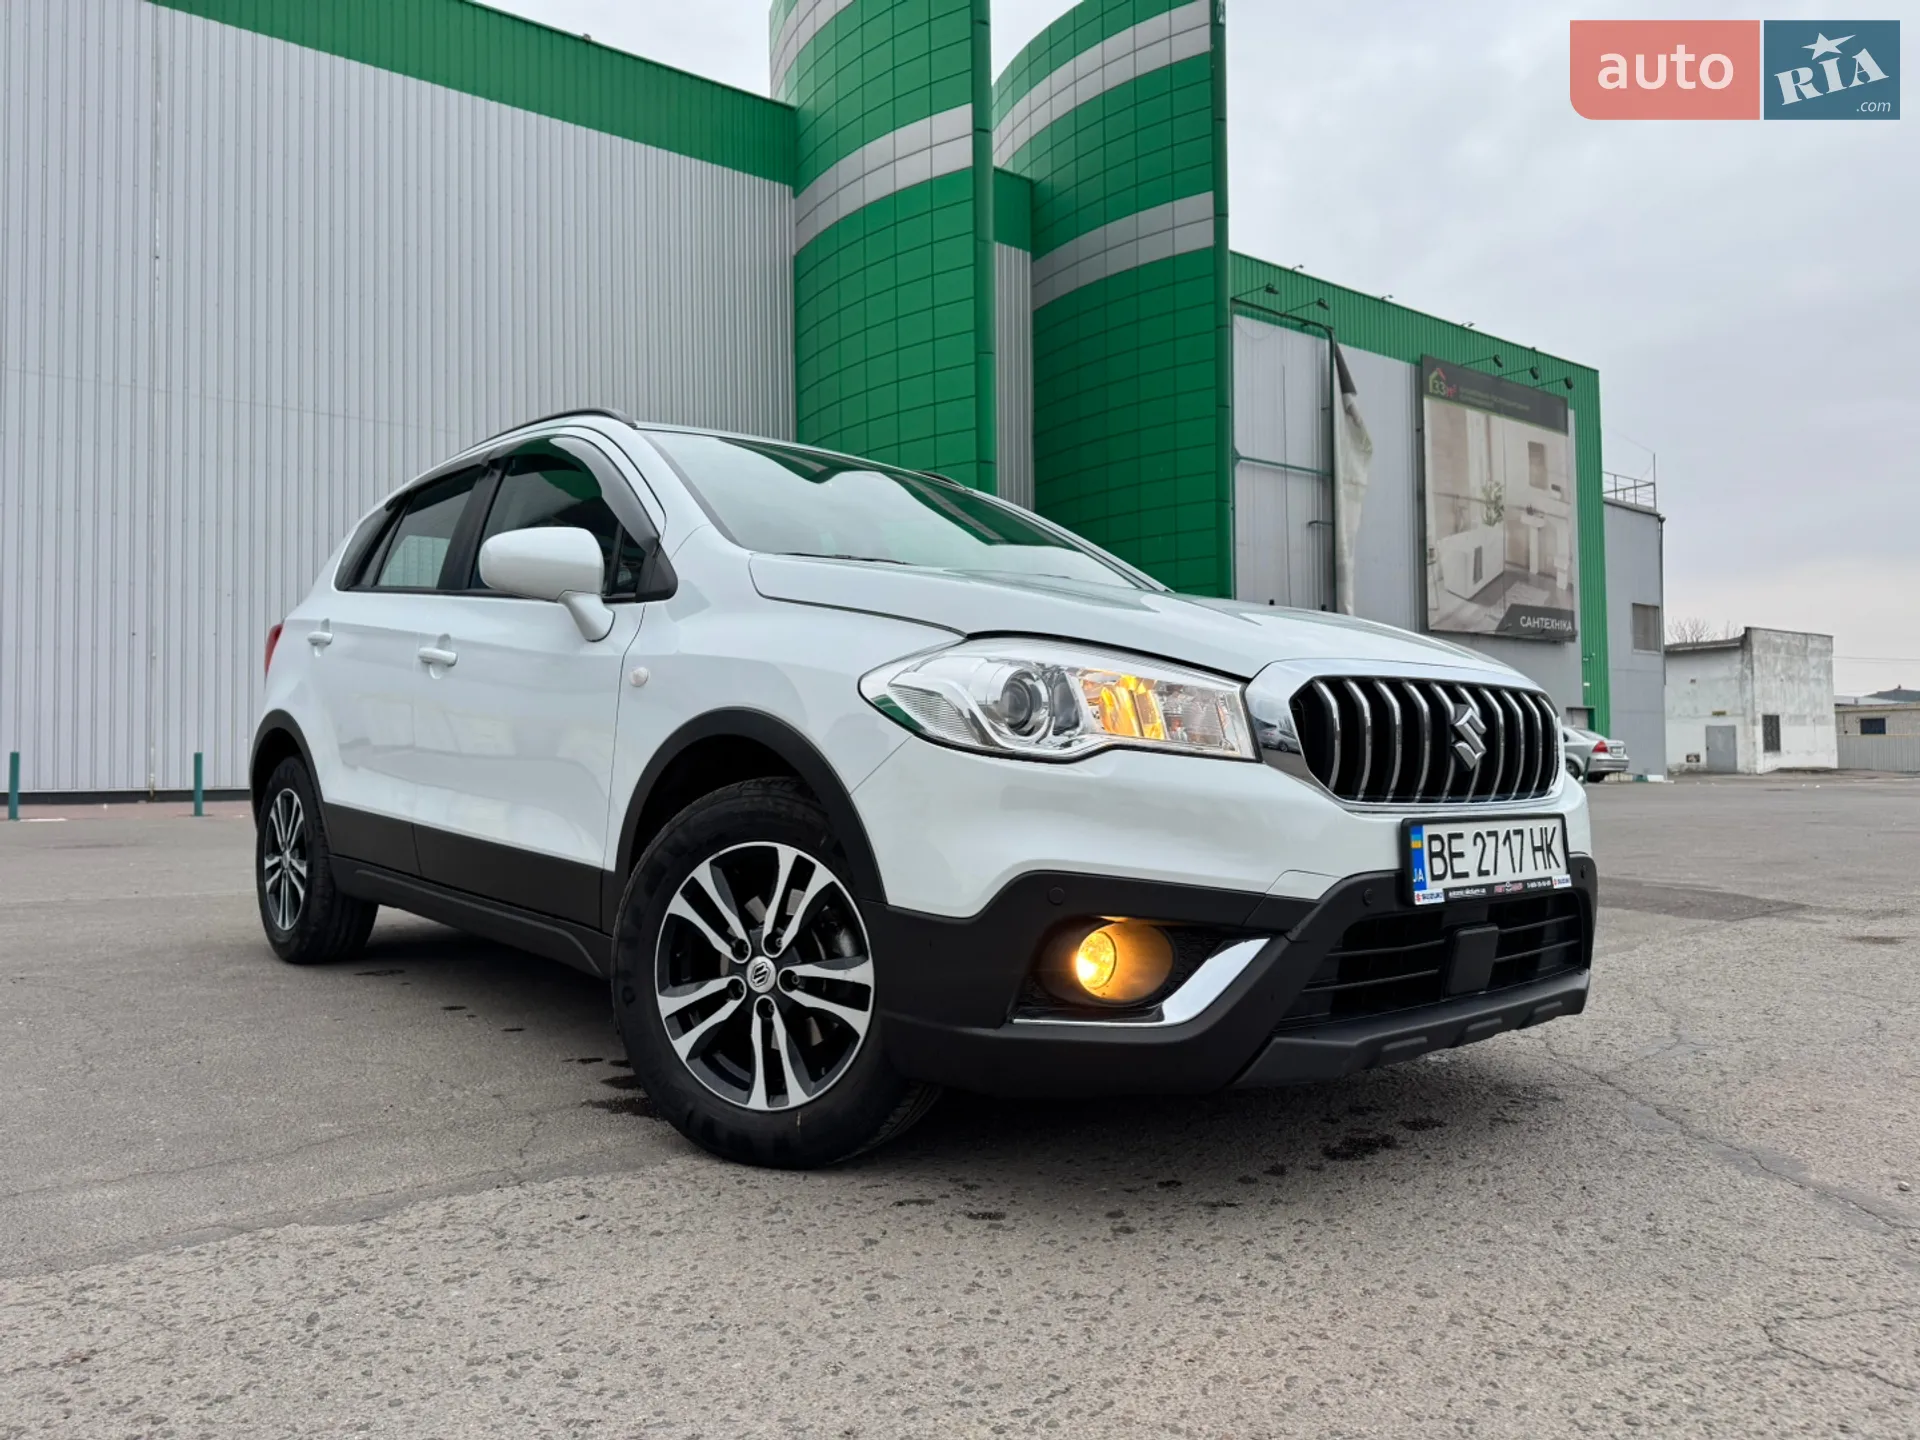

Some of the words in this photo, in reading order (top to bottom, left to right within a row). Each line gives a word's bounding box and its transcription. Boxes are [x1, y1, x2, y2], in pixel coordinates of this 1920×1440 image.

[1520, 616, 1572, 632] САНТЕХНІКА
[1427, 832, 1470, 881] BE
[1473, 829, 1524, 877] 2717
[1530, 826, 1561, 871] HK
